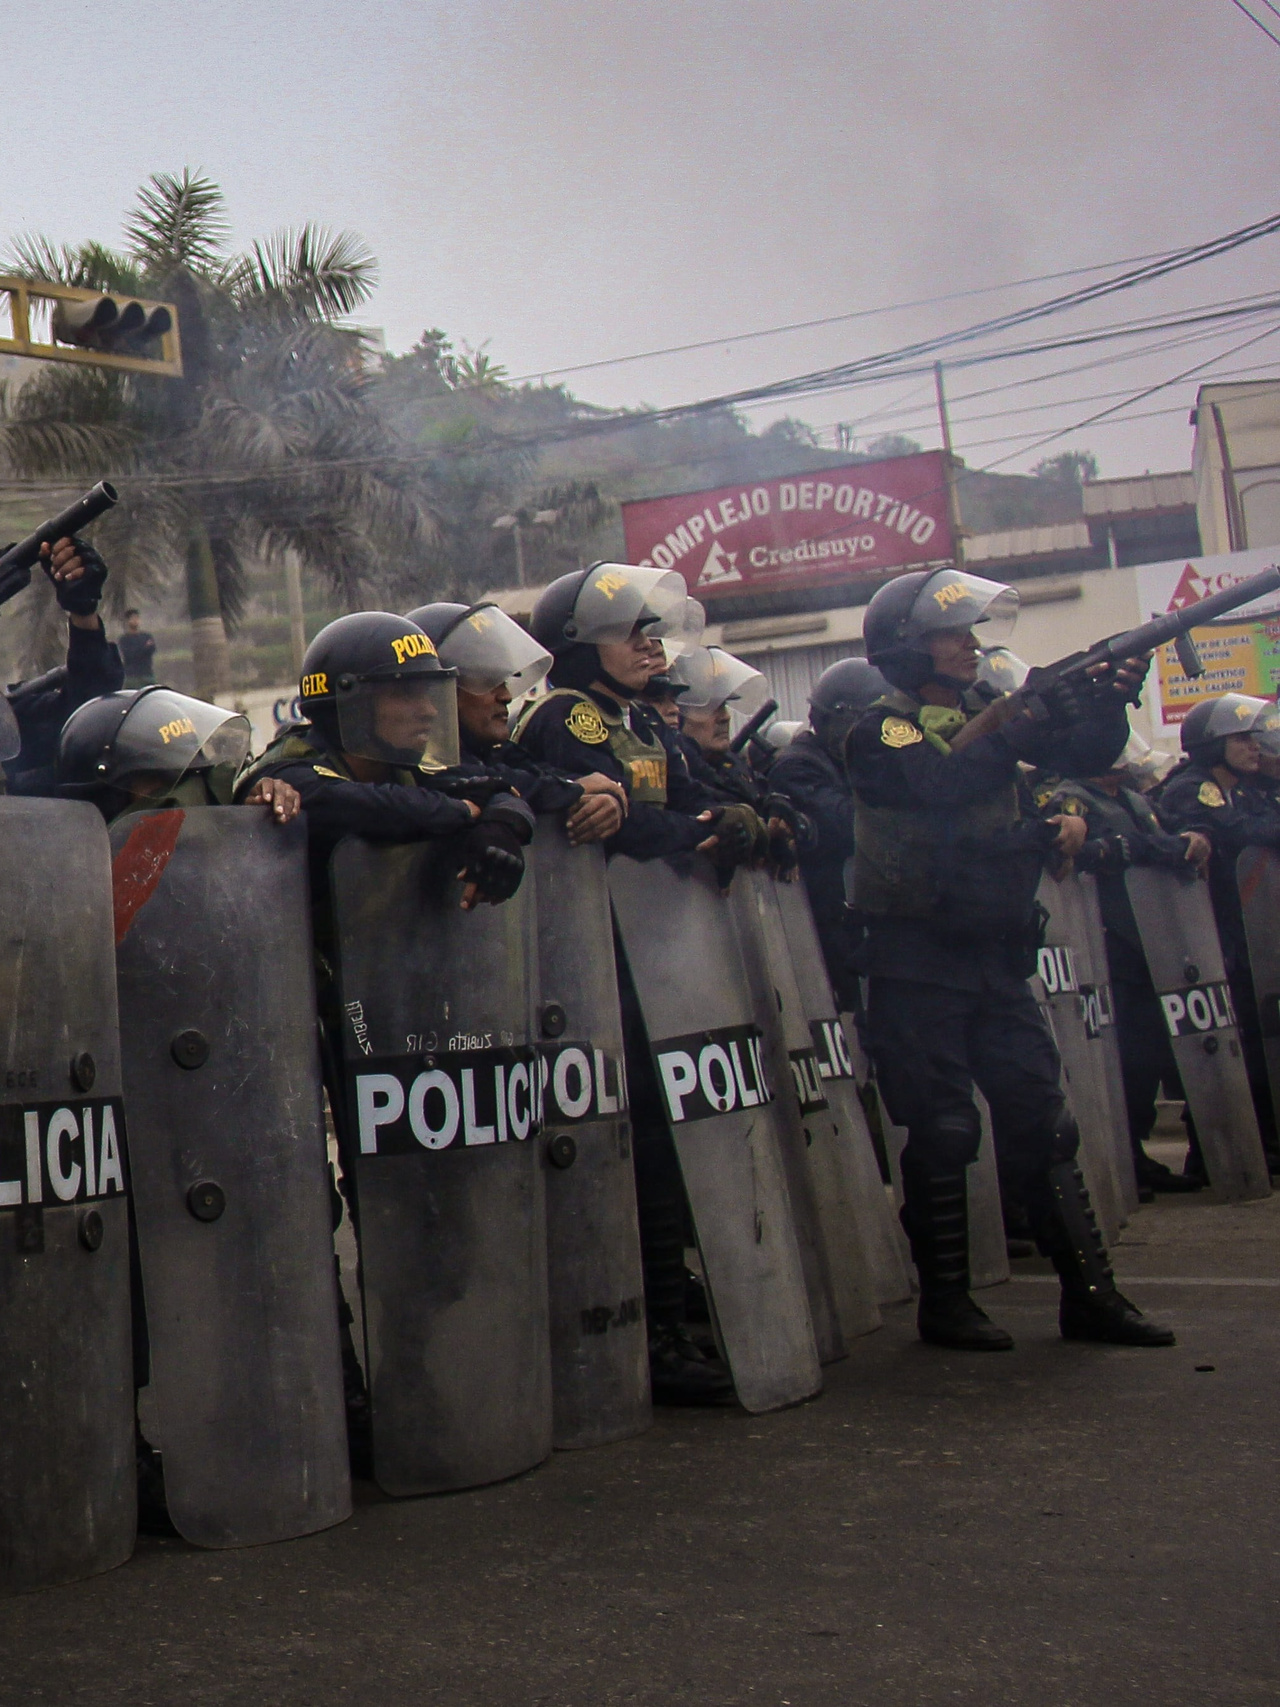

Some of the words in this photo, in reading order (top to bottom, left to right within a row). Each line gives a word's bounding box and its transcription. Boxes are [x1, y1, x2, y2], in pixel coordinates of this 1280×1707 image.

[779, 482, 936, 545] DEPORTIVO
[748, 534, 875, 568] Credisuyo
[302, 672, 329, 697] GIR
